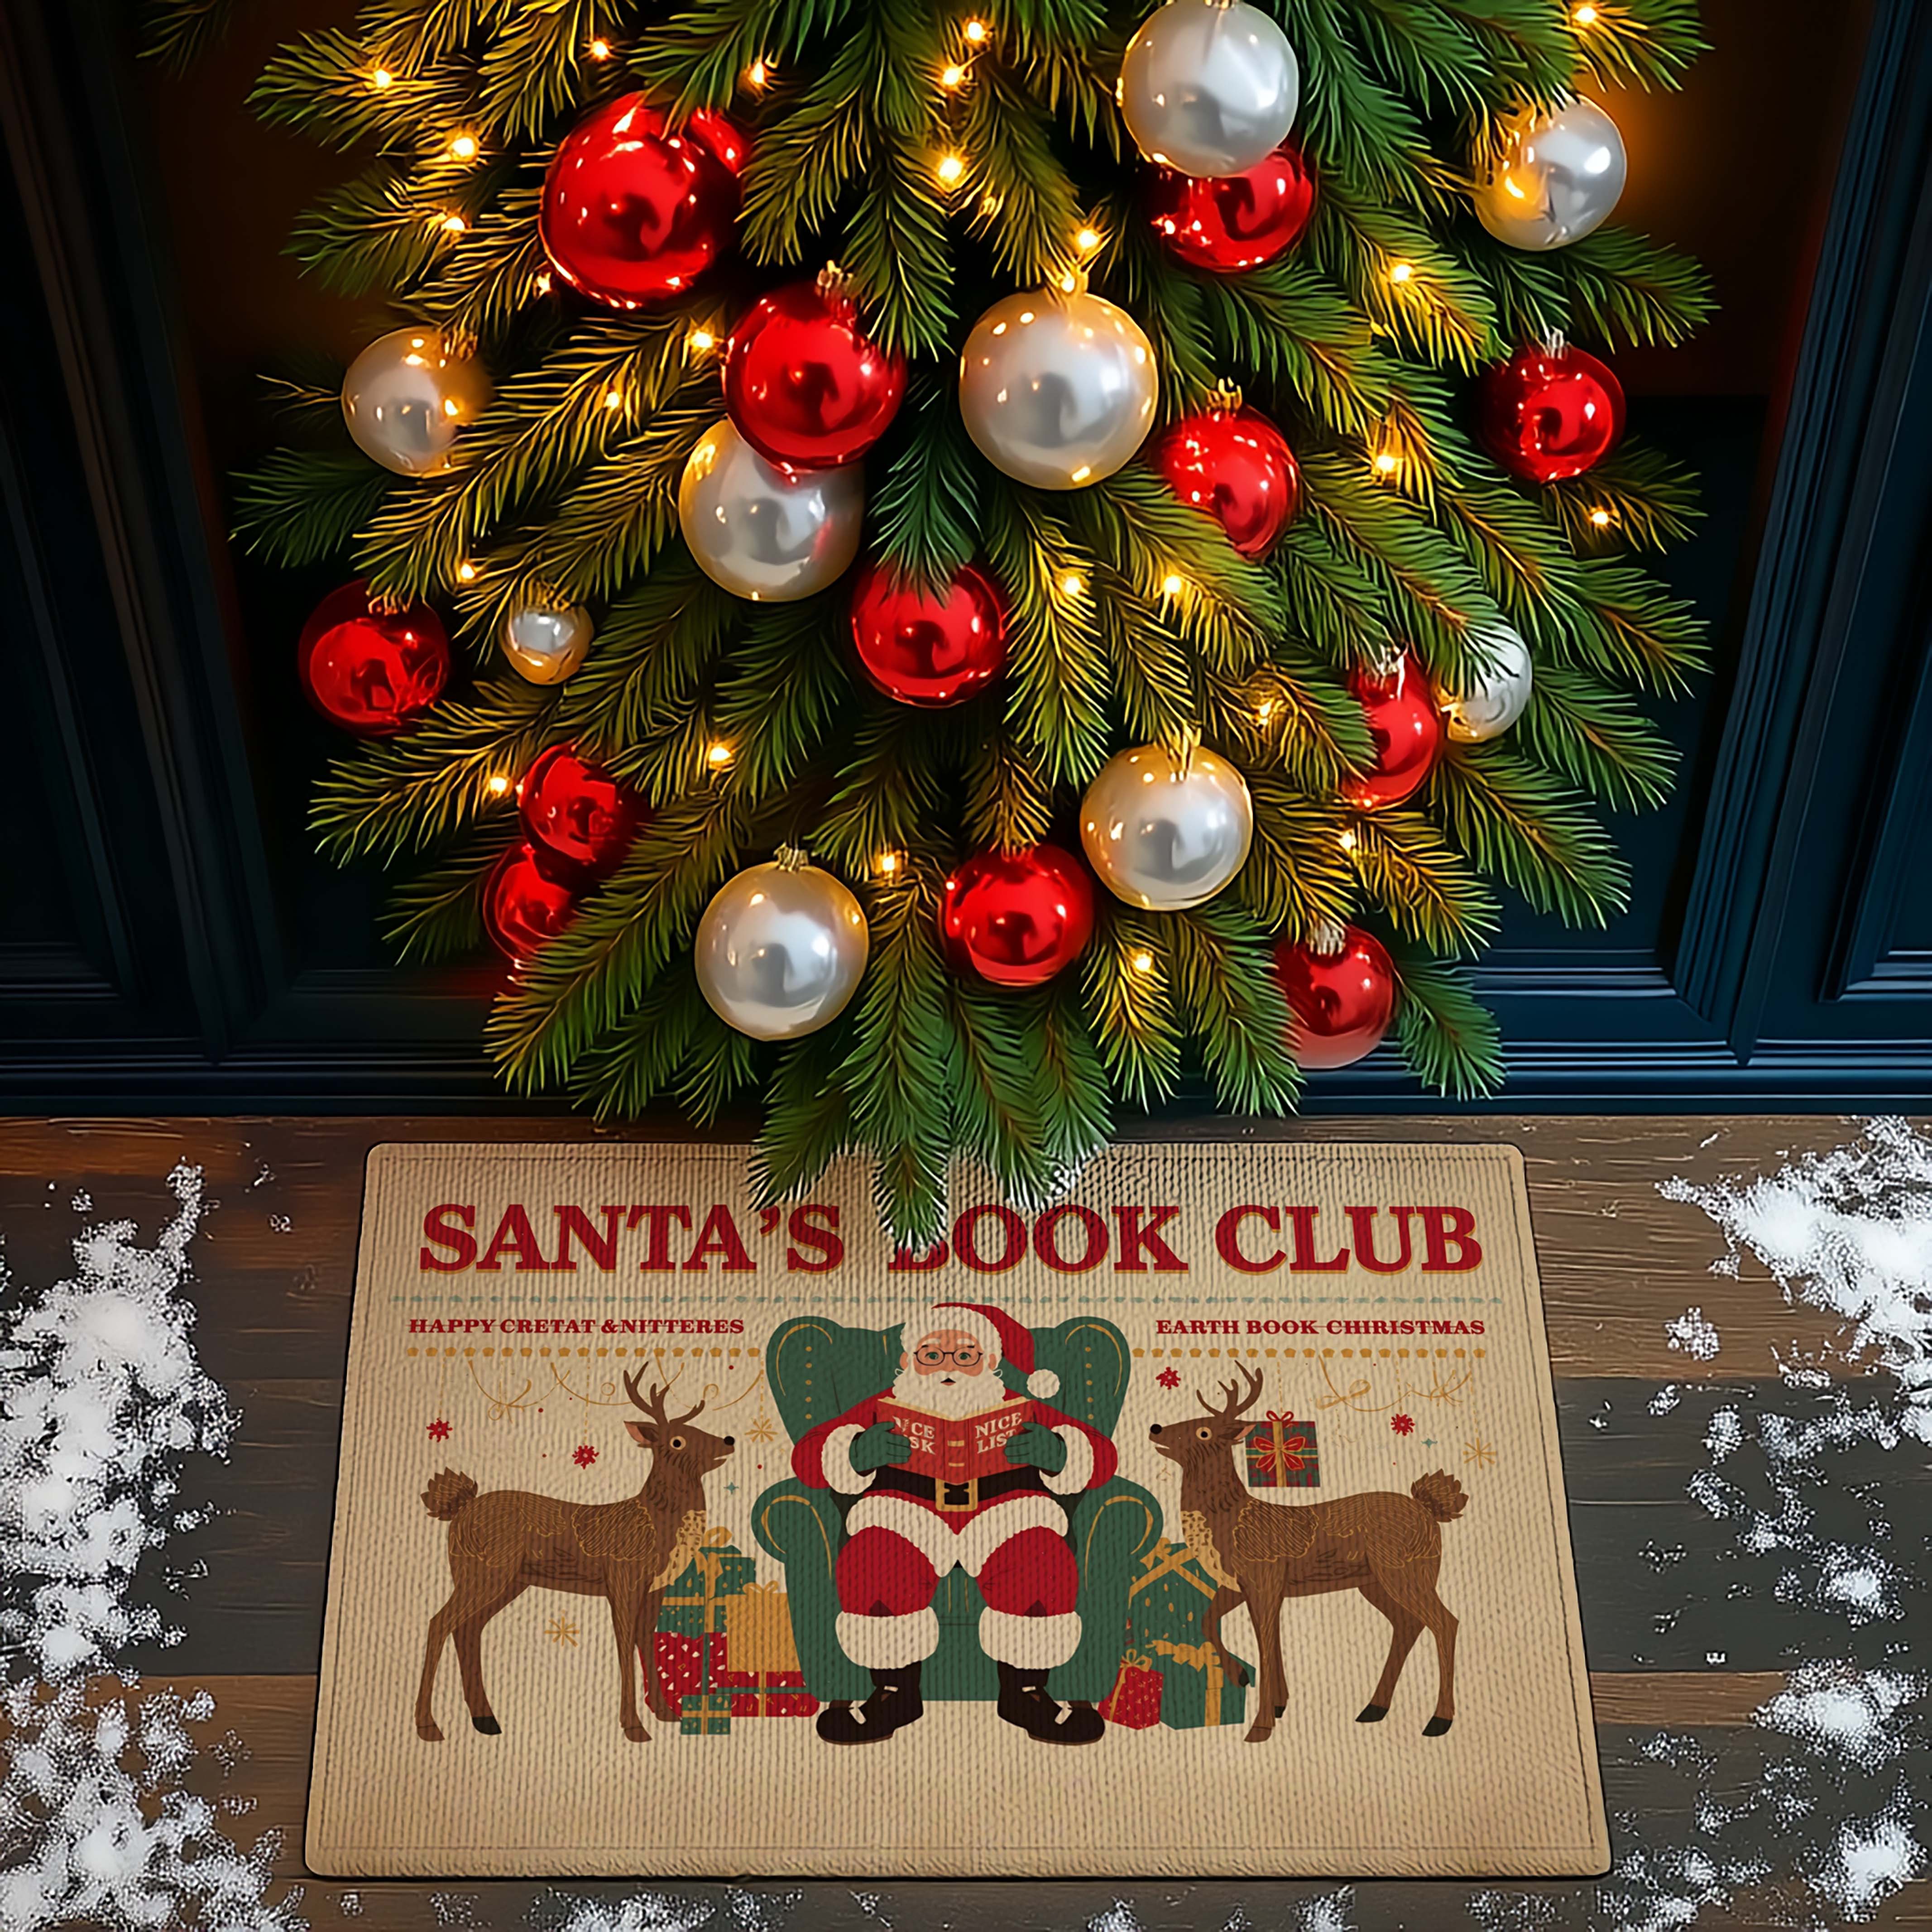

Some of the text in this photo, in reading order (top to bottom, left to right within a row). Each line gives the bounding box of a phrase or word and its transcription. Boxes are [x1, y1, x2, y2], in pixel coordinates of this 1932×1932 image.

[420, 1203, 844, 1274] SANTA'S
[1215, 1204, 1483, 1274] CLUB
[408, 1318, 496, 1333] HAPPY
[499, 1318, 596, 1333] CRETAT
[1155, 1319, 1486, 1335] EARTH BOOK CHIRISTMAS
[974, 1412, 1022, 1438] NICE
